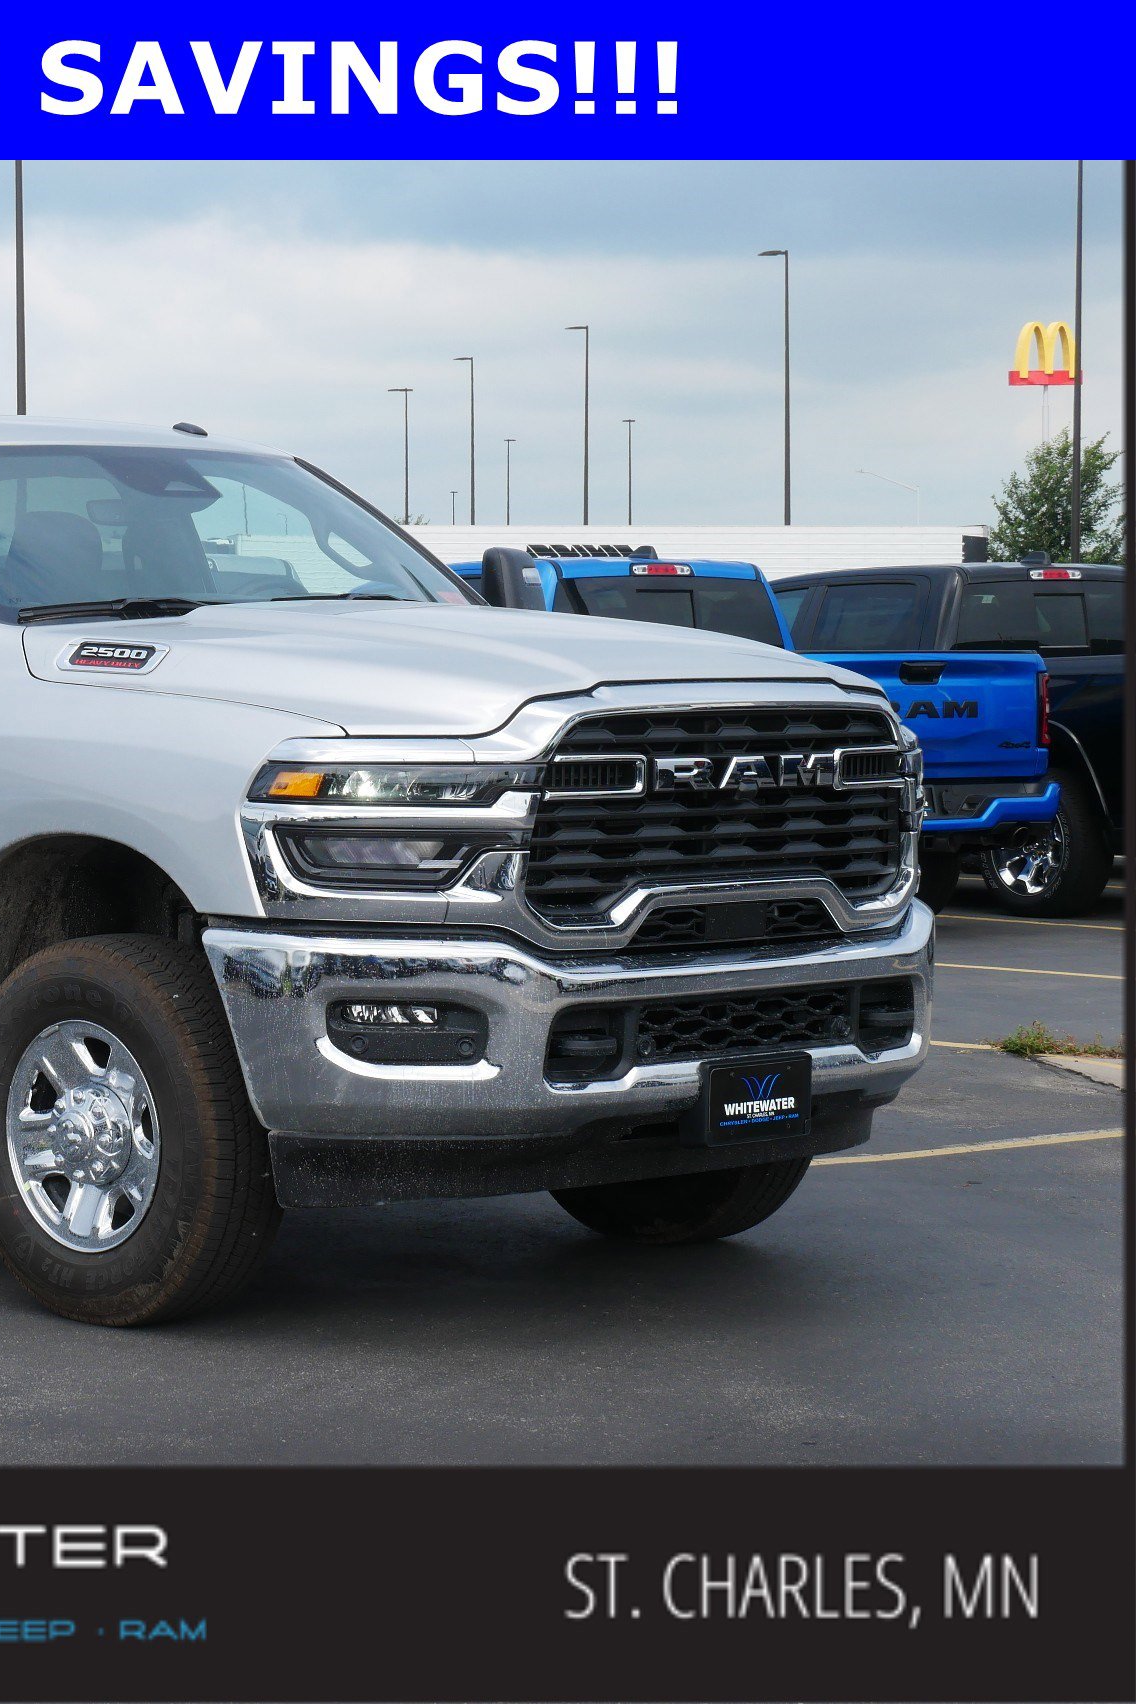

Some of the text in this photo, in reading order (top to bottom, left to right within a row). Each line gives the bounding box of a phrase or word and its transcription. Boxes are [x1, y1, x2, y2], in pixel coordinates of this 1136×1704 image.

[80, 646, 148, 660] 2500
[890, 700, 979, 719] AM
[654, 753, 834, 792] RAM
[724, 1096, 795, 1116] WHITEWATER
